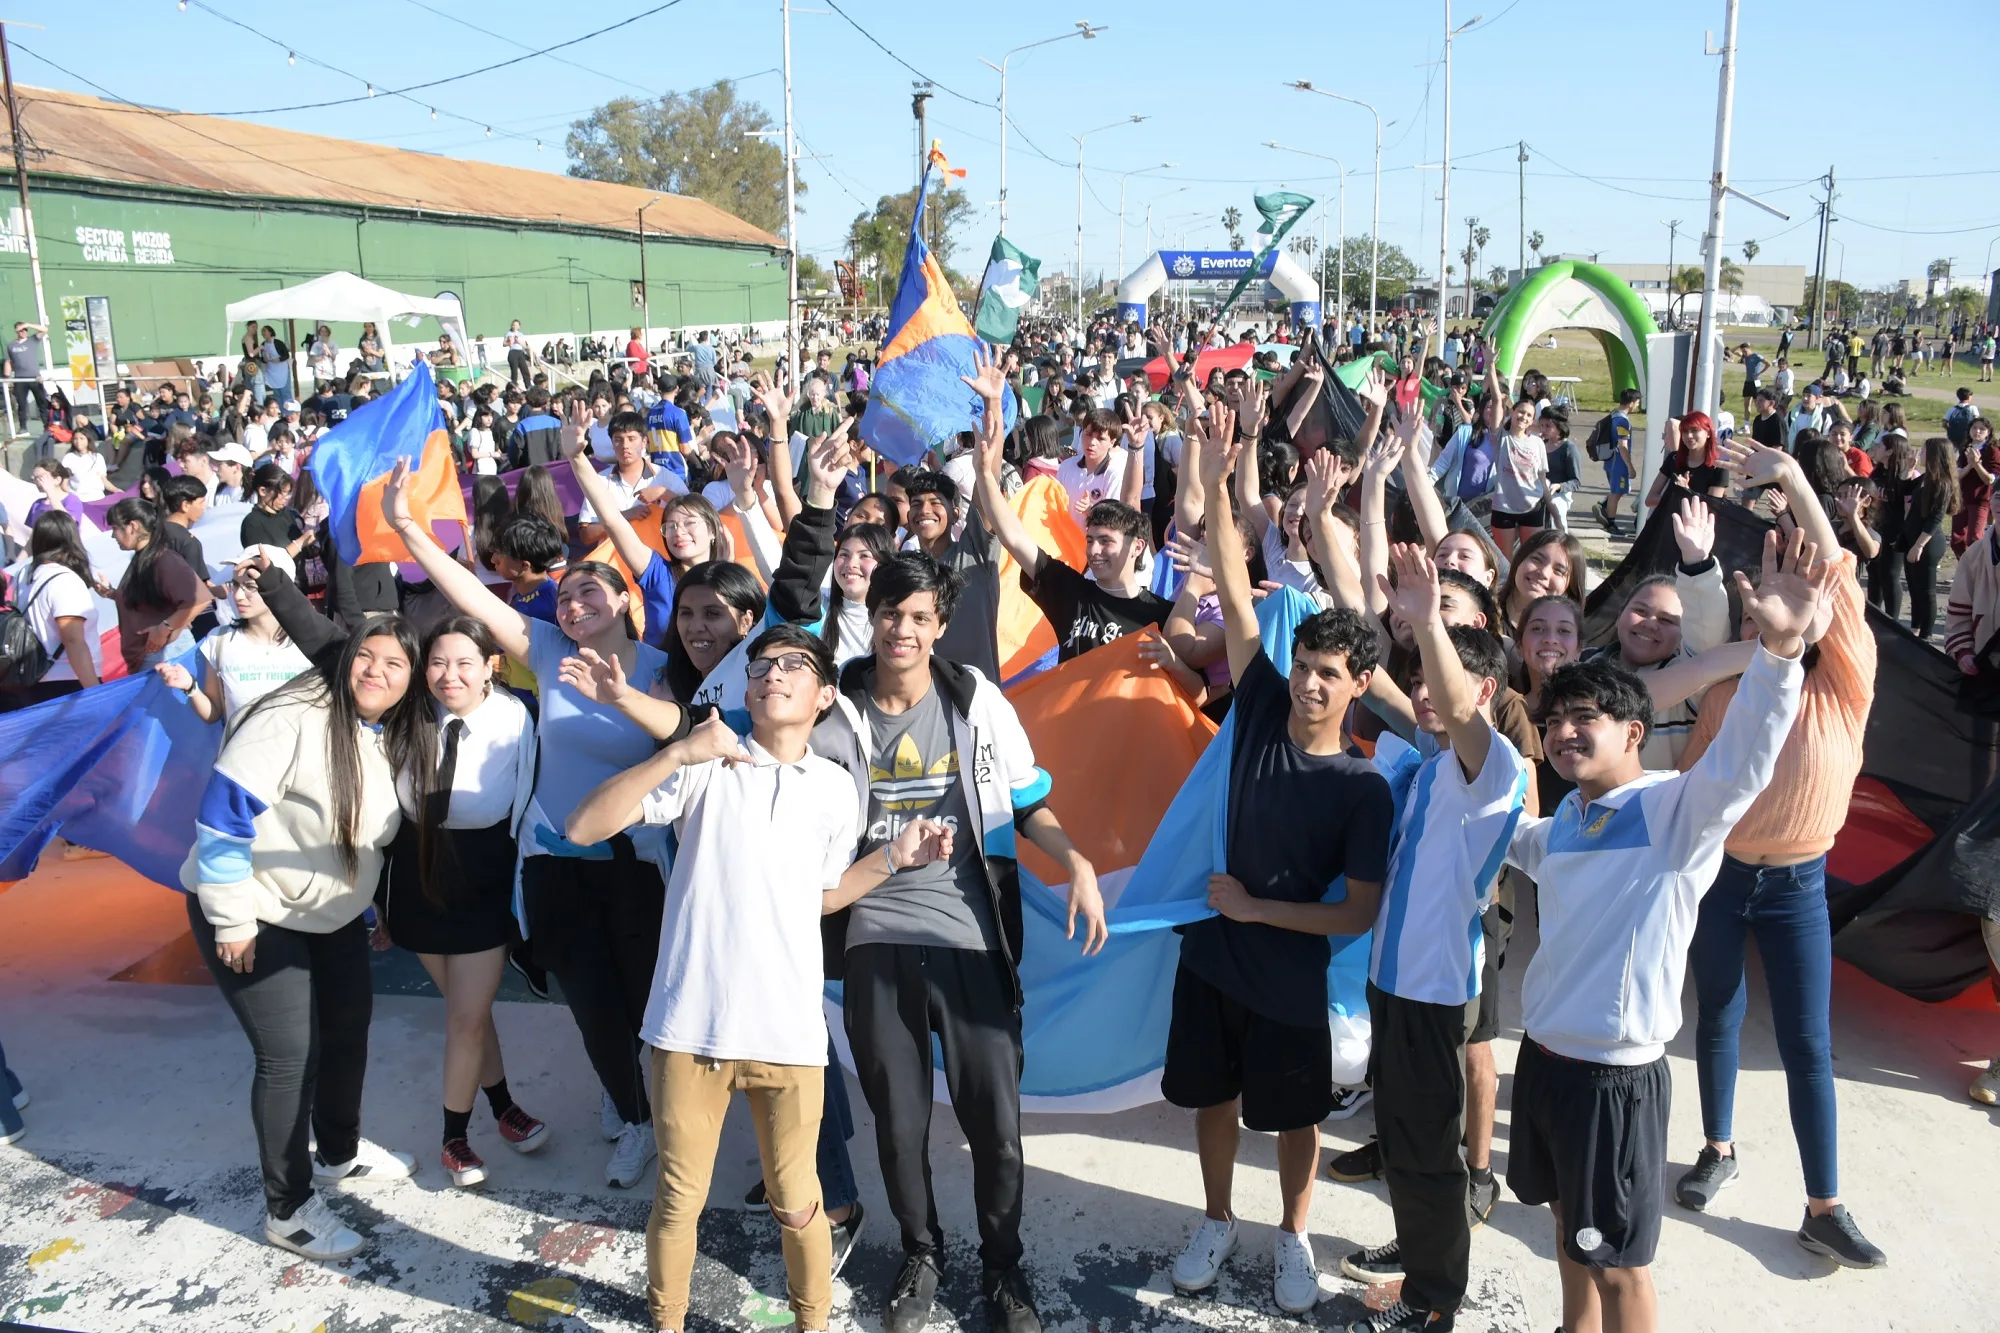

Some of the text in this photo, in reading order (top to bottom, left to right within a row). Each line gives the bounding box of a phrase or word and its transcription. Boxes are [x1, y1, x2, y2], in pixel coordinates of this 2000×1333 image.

[76, 226, 171, 249] SECTOR MOZOS
[83, 245, 175, 264] COMIDA BEBIDA
[1201, 257, 1253, 269] Eventos
[331, 408, 348, 420] 23
[239, 672, 262, 682] BEST
